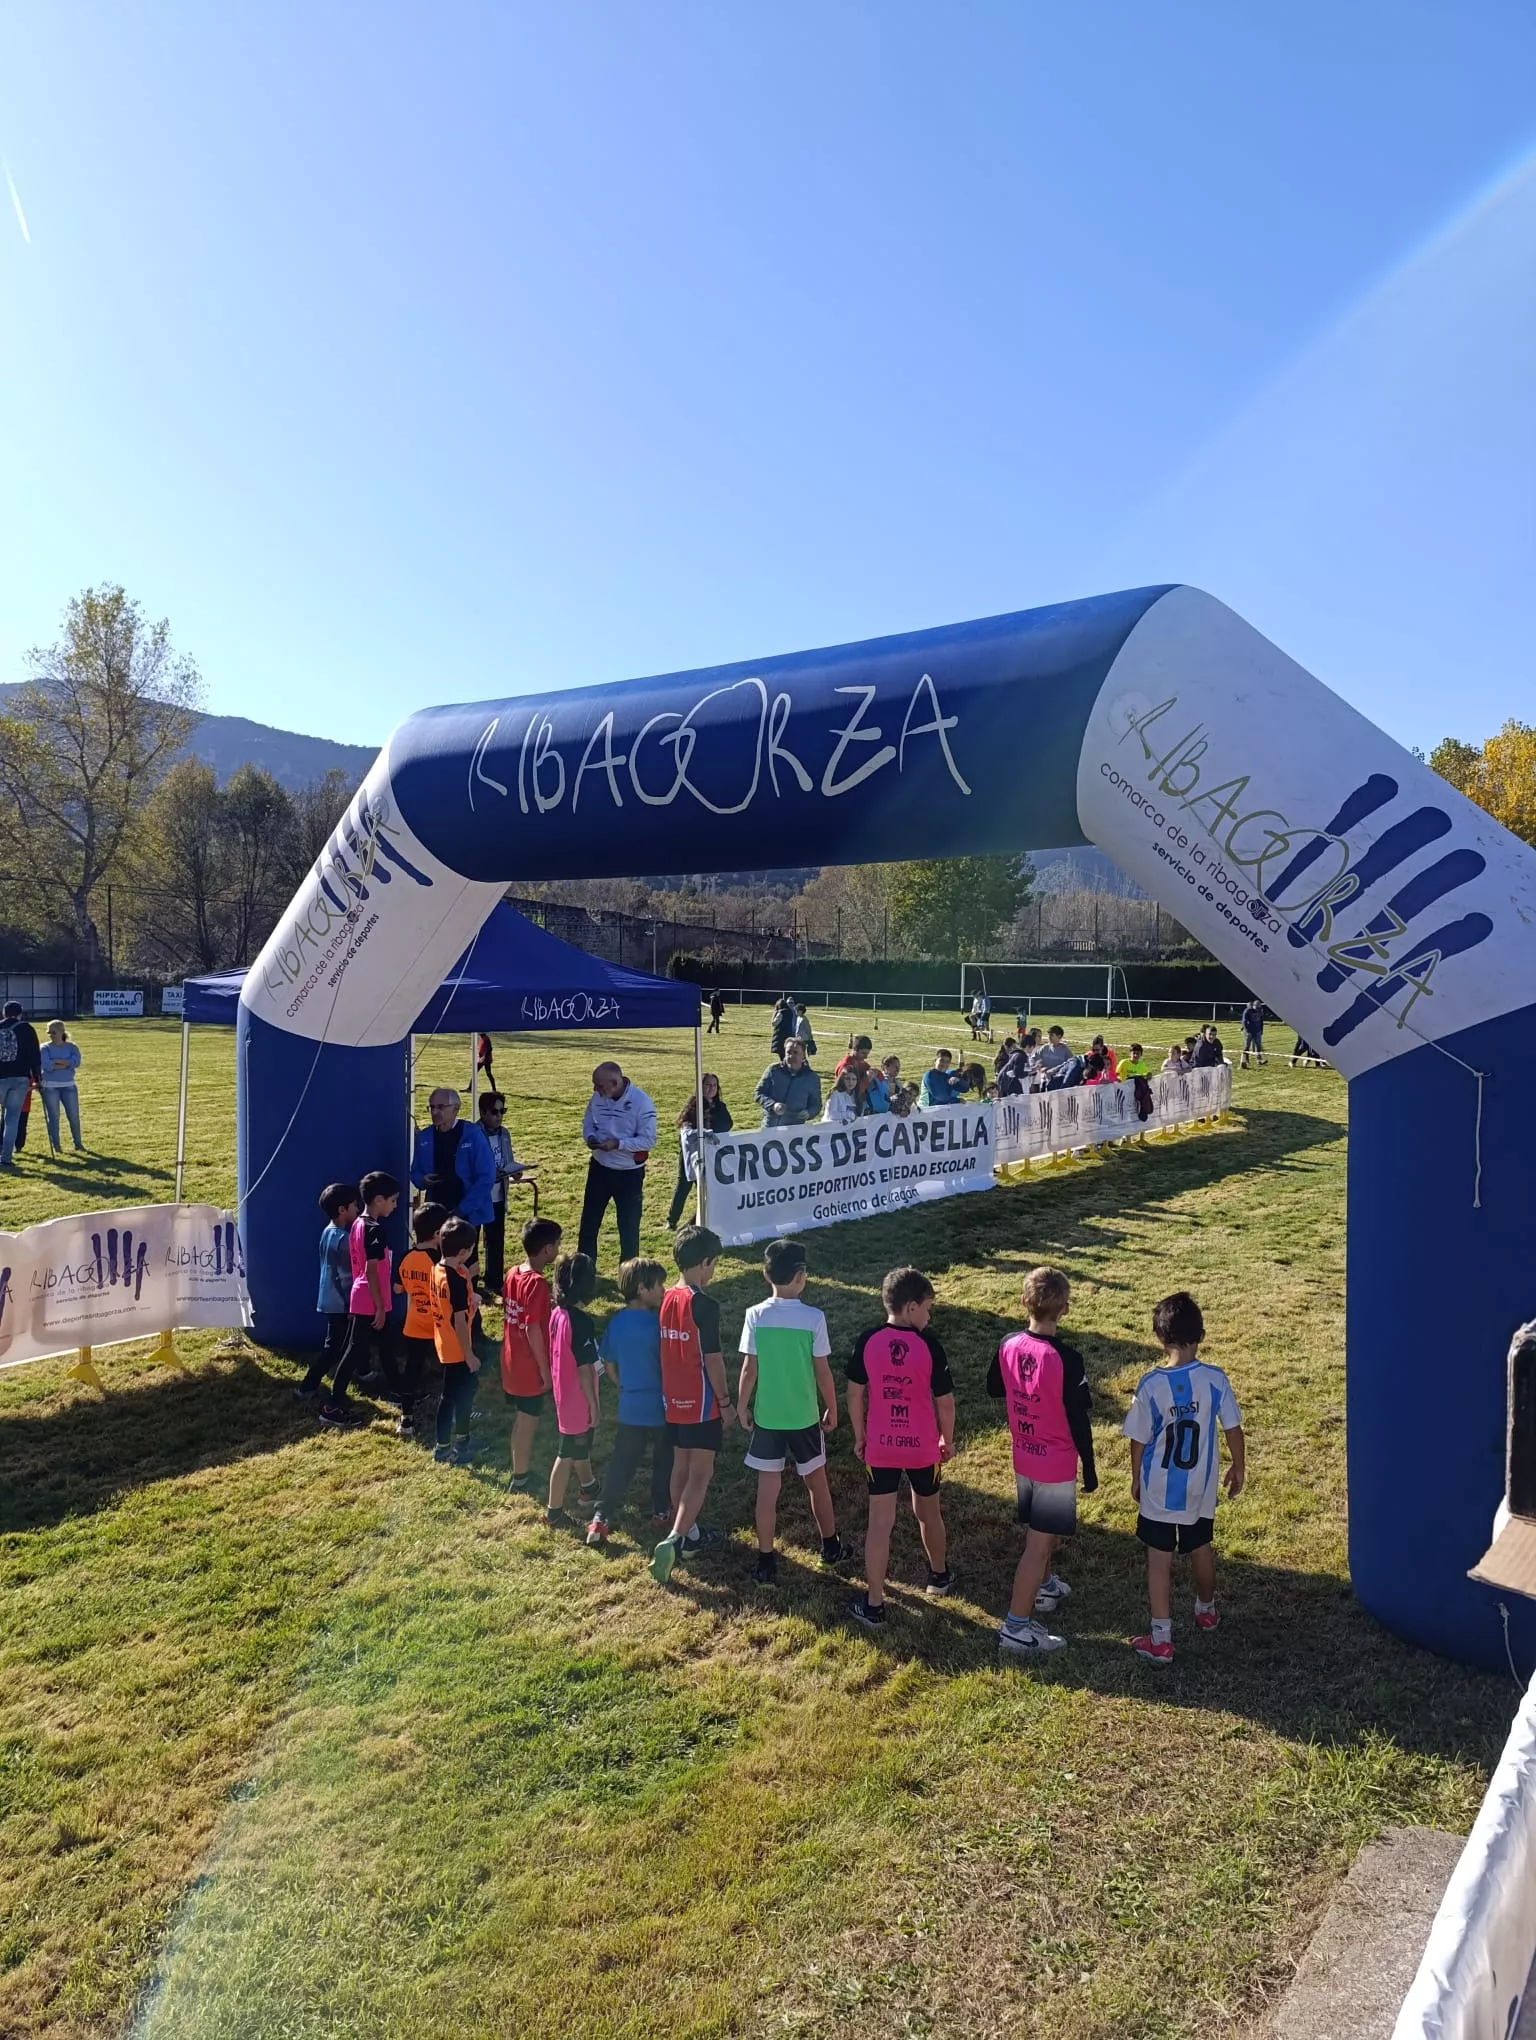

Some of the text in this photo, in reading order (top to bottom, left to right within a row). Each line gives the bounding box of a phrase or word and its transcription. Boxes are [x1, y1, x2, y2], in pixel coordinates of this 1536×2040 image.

[468, 674, 972, 815] RIBAGORZA
[1100, 763, 1282, 934] comarca de la ribagorza
[1118, 697, 1442, 1029] RIBAGORZA
[1152, 841, 1270, 954] servicio de deportes
[286, 974, 319, 1018] comarca
[315, 960, 328, 976] de
[322, 948, 336, 962] la
[327, 913, 380, 988] servicio de deportes
[520, 992, 621, 1022] RIBAGORZA
[714, 1135, 823, 1185] CROSS
[830, 1129, 868, 1168] DE
[874, 1116, 989, 1158] CAPELLA
[736, 1185, 795, 1210] JUEGOS
[798, 1170, 876, 1200] DEPORTIVOS
[929, 1156, 977, 1175] ESCOLAR
[813, 1197, 868, 1220] Gobierno
[871, 1193, 887, 1206] de
[1160, 1418, 1201, 1471] 10
